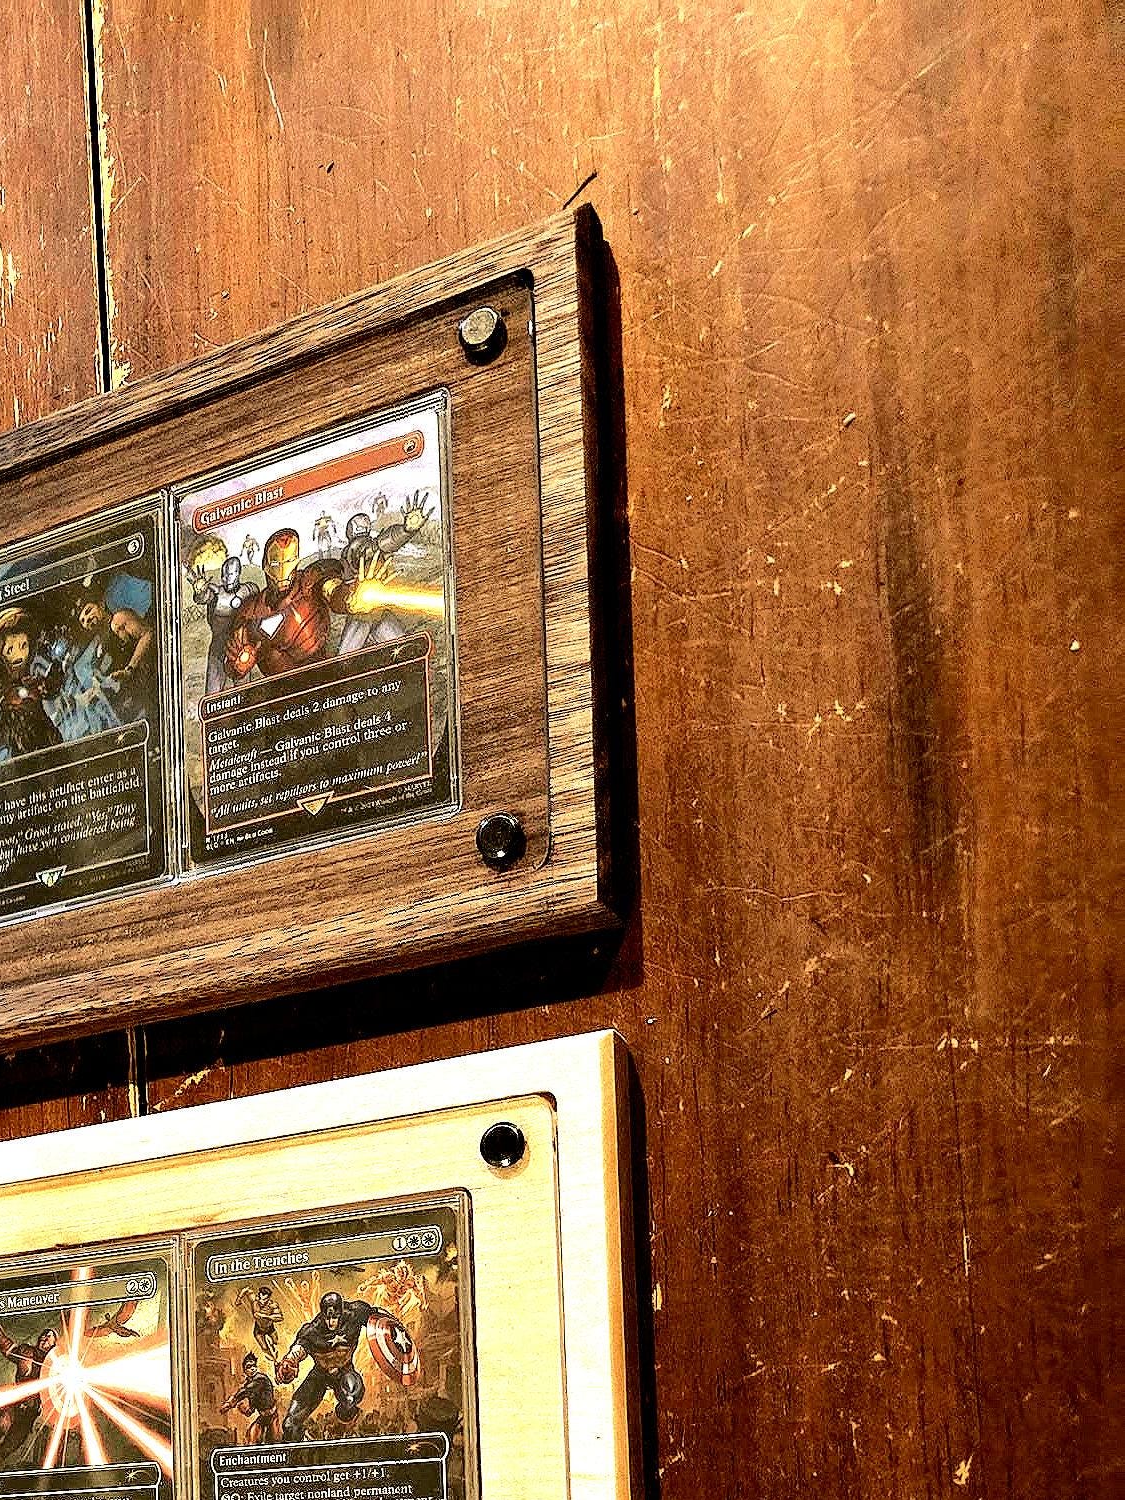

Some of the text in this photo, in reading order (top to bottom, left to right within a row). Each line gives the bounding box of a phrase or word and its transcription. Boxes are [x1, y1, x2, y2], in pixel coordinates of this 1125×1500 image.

[200, 486, 284, 525] Galvanic Blast
[3, 578, 30, 598] Steel
[205, 695, 242, 713] Instant
[207, 722, 253, 742] Galvanic
[254, 713, 281, 729] Blast
[282, 705, 310, 721] deals
[321, 691, 365, 710] damage
[381, 681, 401, 694] any
[208, 748, 257, 770] Metalcraft
[274, 732, 321, 753] Galvanic
[322, 723, 352, 740] Blast
[353, 716, 381, 732] deals
[209, 765, 249, 782] damage
[250, 752, 288, 771] instead
[299, 746, 320, 761] you
[322, 733, 360, 753] control
[362, 728, 392, 743] three
[209, 780, 236, 794] more
[228, 1258, 250, 1272] the
[252, 1252, 309, 1269] Trenches
[7, 1294, 59, 1309] Maneuver
[218, 1453, 287, 1466] Enchantment
[220, 1477, 269, 1488] Creatures
[271, 1476, 290, 1488] you
[292, 1471, 331, 1484] control
[332, 1471, 351, 1485] get
[307, 1487, 350, 1499] nonland
[351, 1485, 413, 1500] permanent
